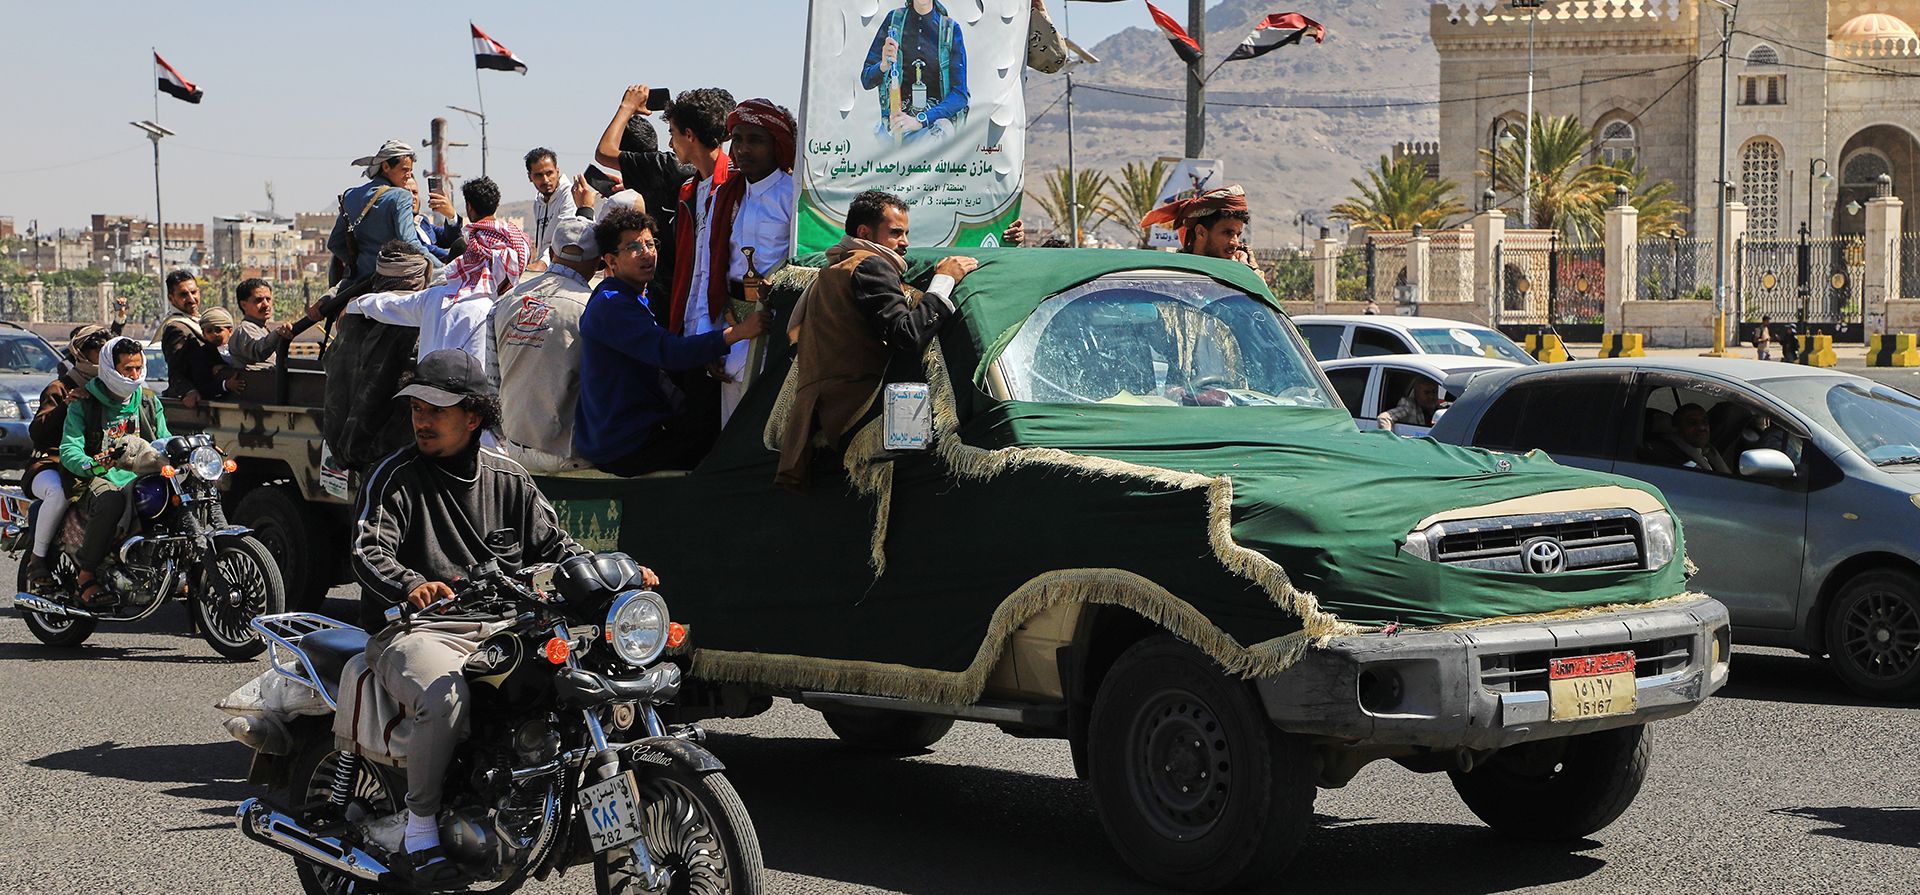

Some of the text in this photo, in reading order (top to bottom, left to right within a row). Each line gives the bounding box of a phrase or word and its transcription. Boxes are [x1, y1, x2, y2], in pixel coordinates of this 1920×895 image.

[808, 139, 832, 155] كيان)
[830, 158, 873, 179] الرياشي
[934, 159, 967, 176] عبدالله
[969, 160, 993, 177] مازن
[927, 196, 933, 205] 3
[965, 197, 982, 207] تاريخ
[1573, 678, 1613, 698] ١٥١٦٧
[1576, 699, 1612, 716] 15167
[632, 744, 673, 767] Cadillac
[596, 782, 617, 803] اليمن
[591, 800, 621, 831] ٢٨٢
[599, 829, 623, 847] 282
